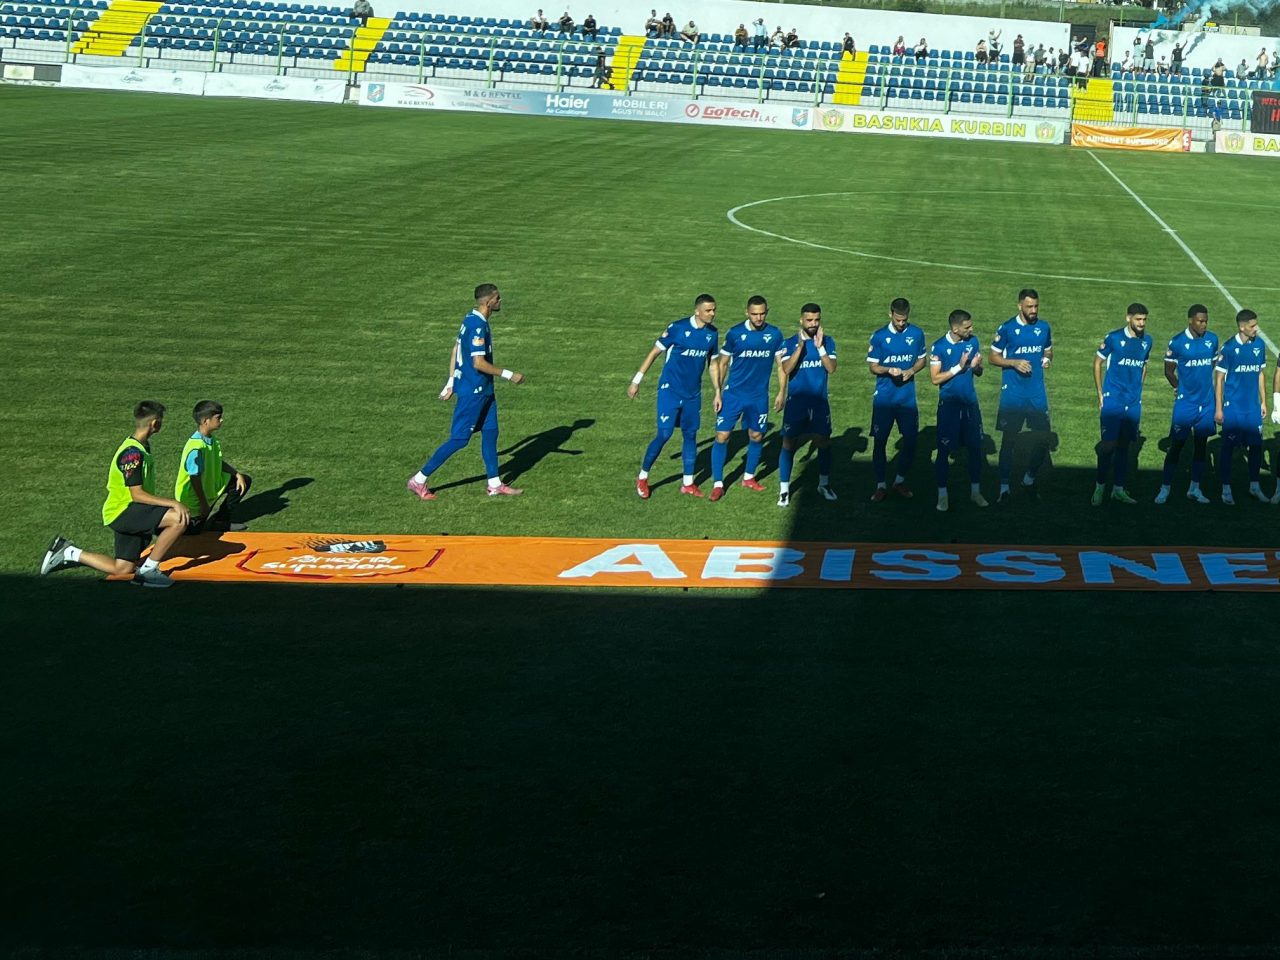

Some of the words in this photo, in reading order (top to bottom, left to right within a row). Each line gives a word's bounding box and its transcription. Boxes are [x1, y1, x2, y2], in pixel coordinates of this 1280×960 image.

[545, 94, 590, 109] Haier
[612, 99, 668, 110] MOBILERI
[703, 106, 760, 119] GoTech
[853, 114, 943, 133] BASHKIA
[950, 119, 1026, 138] KURBIN
[744, 349, 770, 358] RAMS
[1021, 345, 1042, 354] RAMS
[890, 354, 913, 363] RAMS
[1124, 358, 1144, 367] RAMS
[1192, 358, 1212, 367] RAMS
[1240, 364, 1260, 373] RAMS
[758, 413, 768, 424] 77
